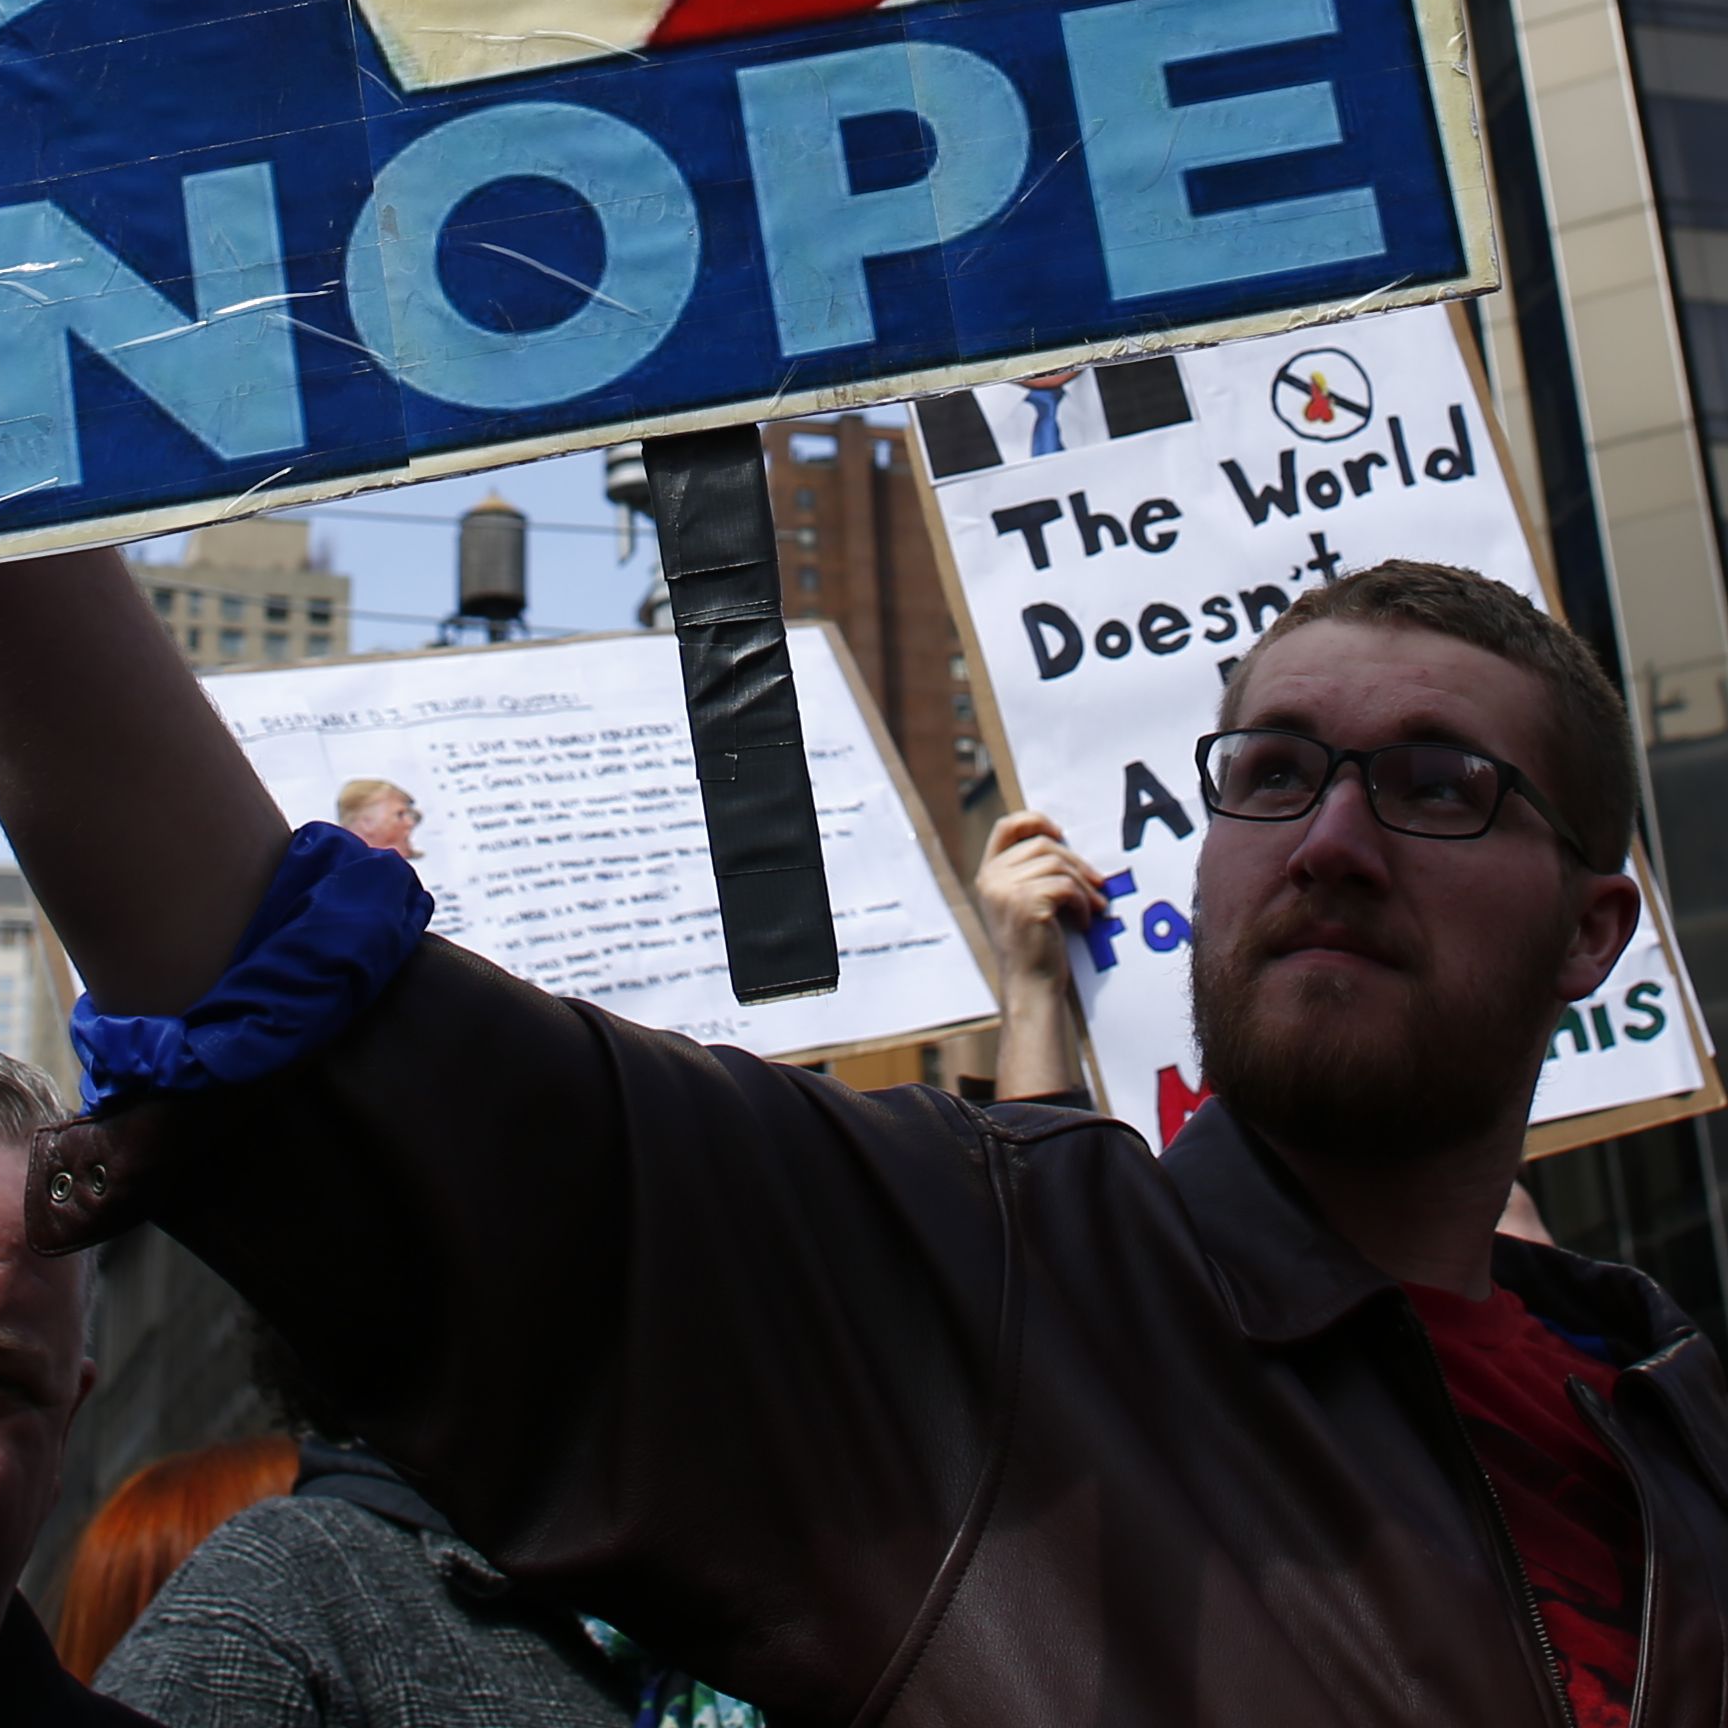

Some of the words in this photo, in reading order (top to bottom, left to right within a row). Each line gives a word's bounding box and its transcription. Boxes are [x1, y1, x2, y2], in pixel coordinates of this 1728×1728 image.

[991, 490, 1183, 571] The
[1219, 404, 1476, 527] World
[1021, 531, 1342, 681] Doesn't
